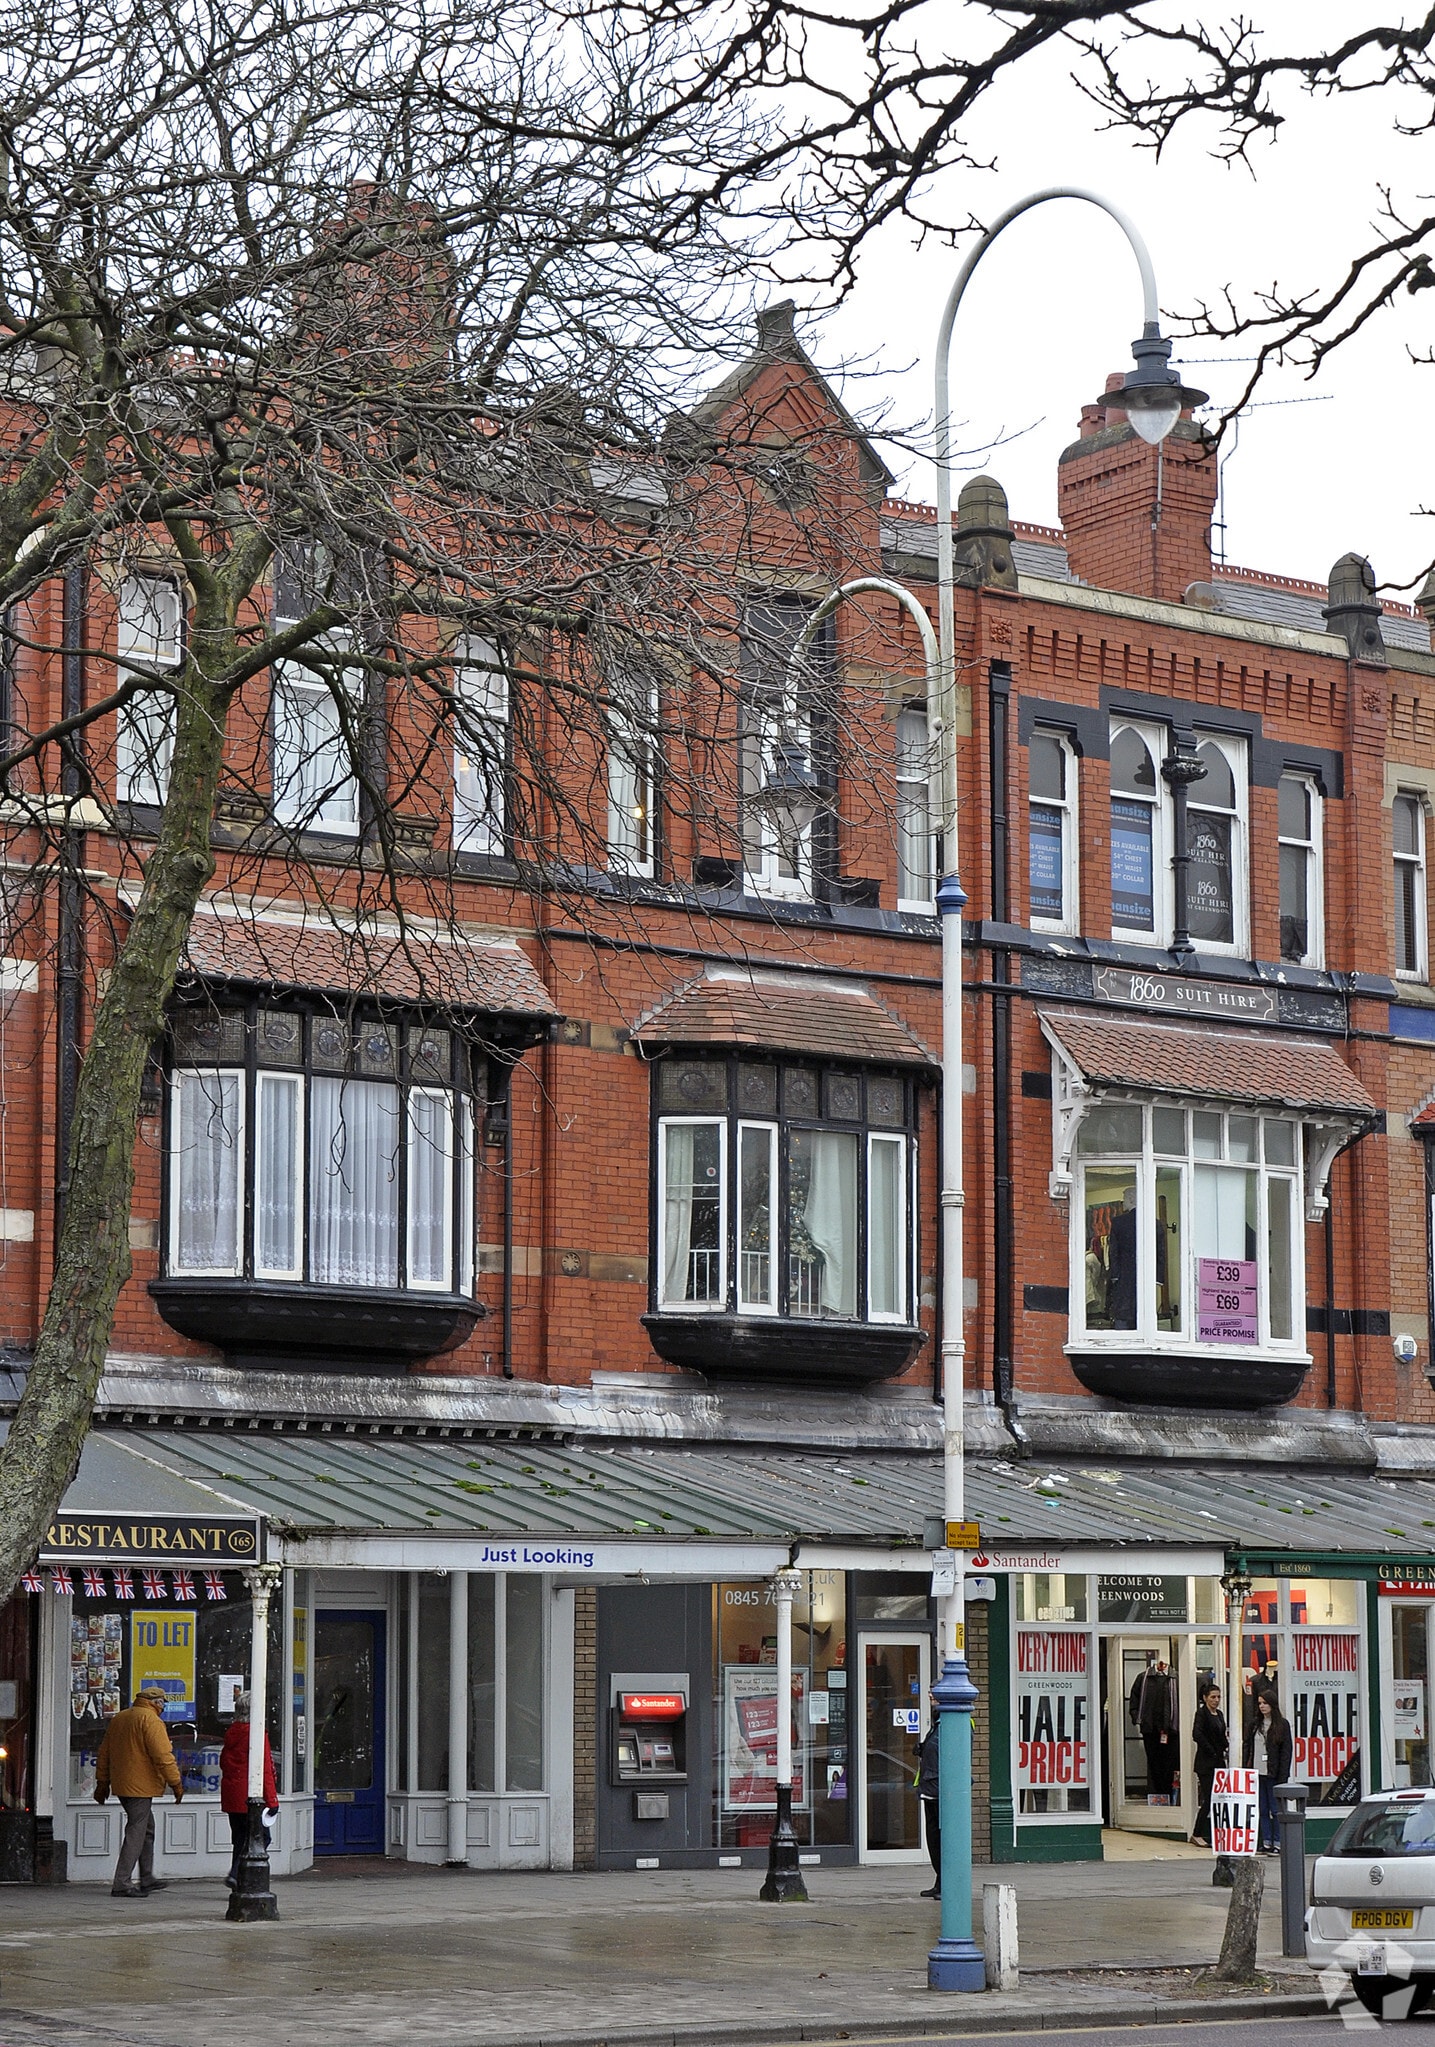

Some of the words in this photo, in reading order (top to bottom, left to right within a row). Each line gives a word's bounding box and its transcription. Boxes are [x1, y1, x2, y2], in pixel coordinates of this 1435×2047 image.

[1111, 803, 1150, 819] ansize
[1121, 842, 1149, 853] AVAILABLE
[1197, 835, 1217, 849] 1860
[1038, 854, 1053, 862] CHEST
[1125, 854, 1142, 863] CHEST
[1124, 864, 1143, 873] WAIST
[1123, 874, 1145, 883] COLLAR
[1197, 881, 1218, 896] 1860
[1111, 901, 1151, 916] ansize
[1129, 975, 1165, 1000] 1860
[1176, 988, 1211, 1003] SUIT
[1218, 993, 1257, 1008] HIRE
[1216, 1266, 1240, 1282] £39
[1216, 1295, 1240, 1310] £69
[1200, 1327, 1221, 1336] PRICE
[1222, 1328, 1255, 1338] PROMISE
[233, 1536, 251, 1547] 165
[957, 1533, 977, 1541] stopping
[481, 1547, 517, 1562] Just
[523, 1549, 594, 1567] Looking
[993, 1552, 1060, 1568] Santander
[1294, 1564, 1311, 1573] 1860
[1147, 1576, 1162, 1587] TO
[725, 1591, 759, 1606] 0845
[136, 1622, 157, 1647] TO
[163, 1622, 191, 1647] LET
[1028, 1682, 1073, 1690] GREENWOODS
[642, 1699, 676, 1707] Santander
[746, 1711, 758, 1719] 123
[1019, 1696, 1086, 1742] HALF
[1294, 1694, 1357, 1737] HALF
[748, 1721, 760, 1729] 123
[1214, 1770, 1255, 1794] SALE
[1346, 1787, 1357, 1801] now
[1213, 1803, 1256, 1829] HALF
[1214, 1828, 1255, 1852] PRICE
[1355, 1912, 1382, 1926] FP06
[1385, 1912, 1408, 1926] DGV
